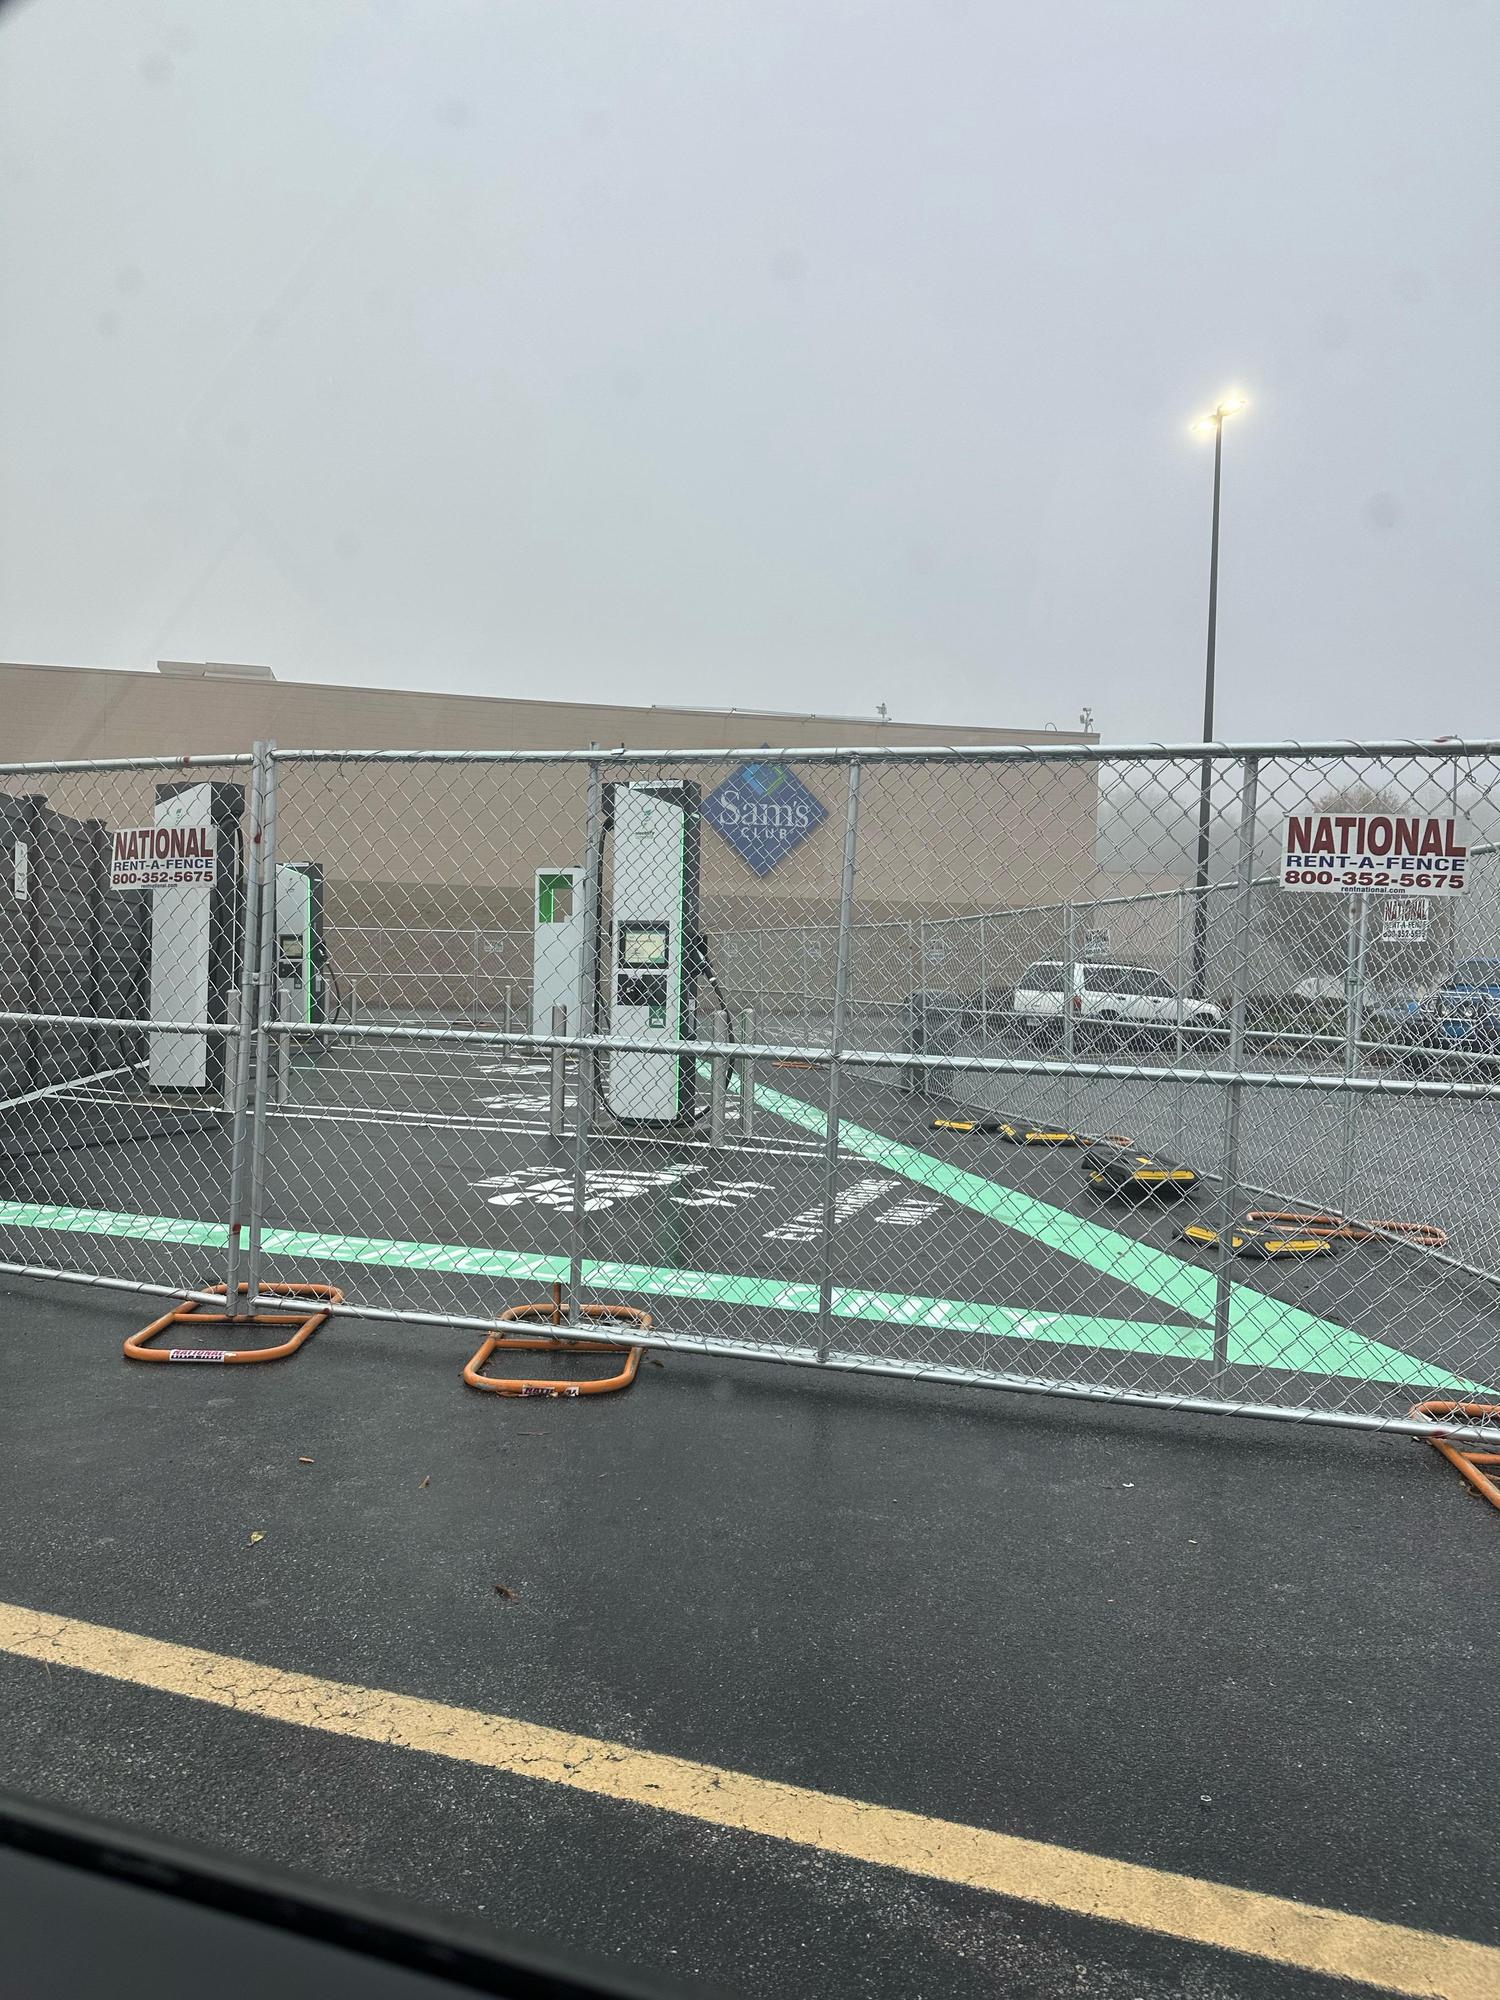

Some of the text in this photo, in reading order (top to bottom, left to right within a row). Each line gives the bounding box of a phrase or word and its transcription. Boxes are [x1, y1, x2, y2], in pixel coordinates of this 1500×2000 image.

[720, 790, 809, 828] Sam's
[741, 827, 788, 840] CLUB
[1287, 816, 1467, 857] NATIONAL
[114, 828, 214, 860] NATIONAL
[113, 859, 214, 871] RENT-A-FENCE
[1286, 855, 1466, 872] RENT-A-FENCE
[112, 871, 214, 885] 800-352-5675
[1285, 870, 1465, 889] 800-352-5675
[1340, 886, 1406, 894] rentnational.com
